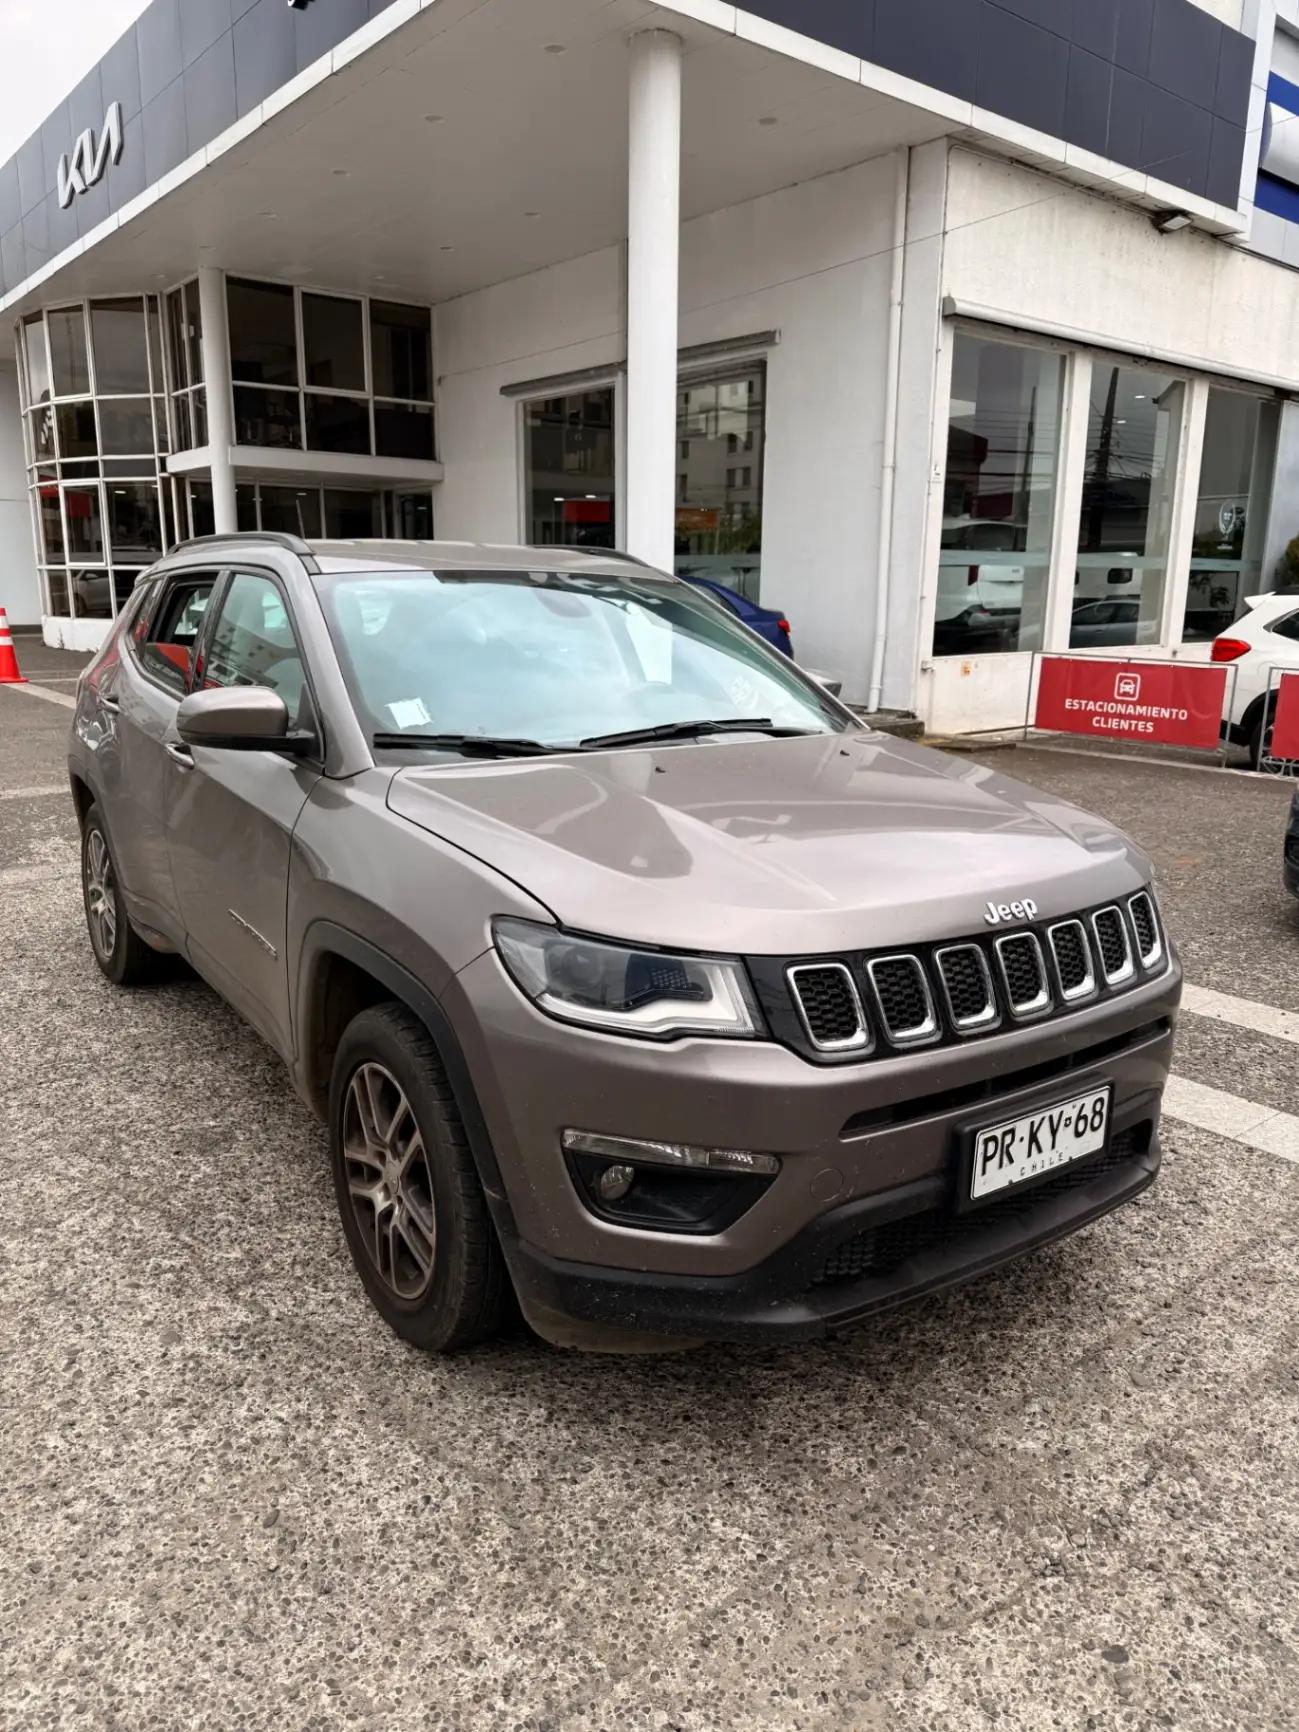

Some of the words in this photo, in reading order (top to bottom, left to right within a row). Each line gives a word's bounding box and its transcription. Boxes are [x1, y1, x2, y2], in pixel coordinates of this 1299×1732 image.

[57, 101, 123, 209] KIA
[1064, 698, 1188, 721] ESTACIONAMIENTO
[1092, 716, 1154, 733] CLIENTES
[983, 898, 1038, 924] Jeep
[1019, 1151, 1064, 1176] CHILE
